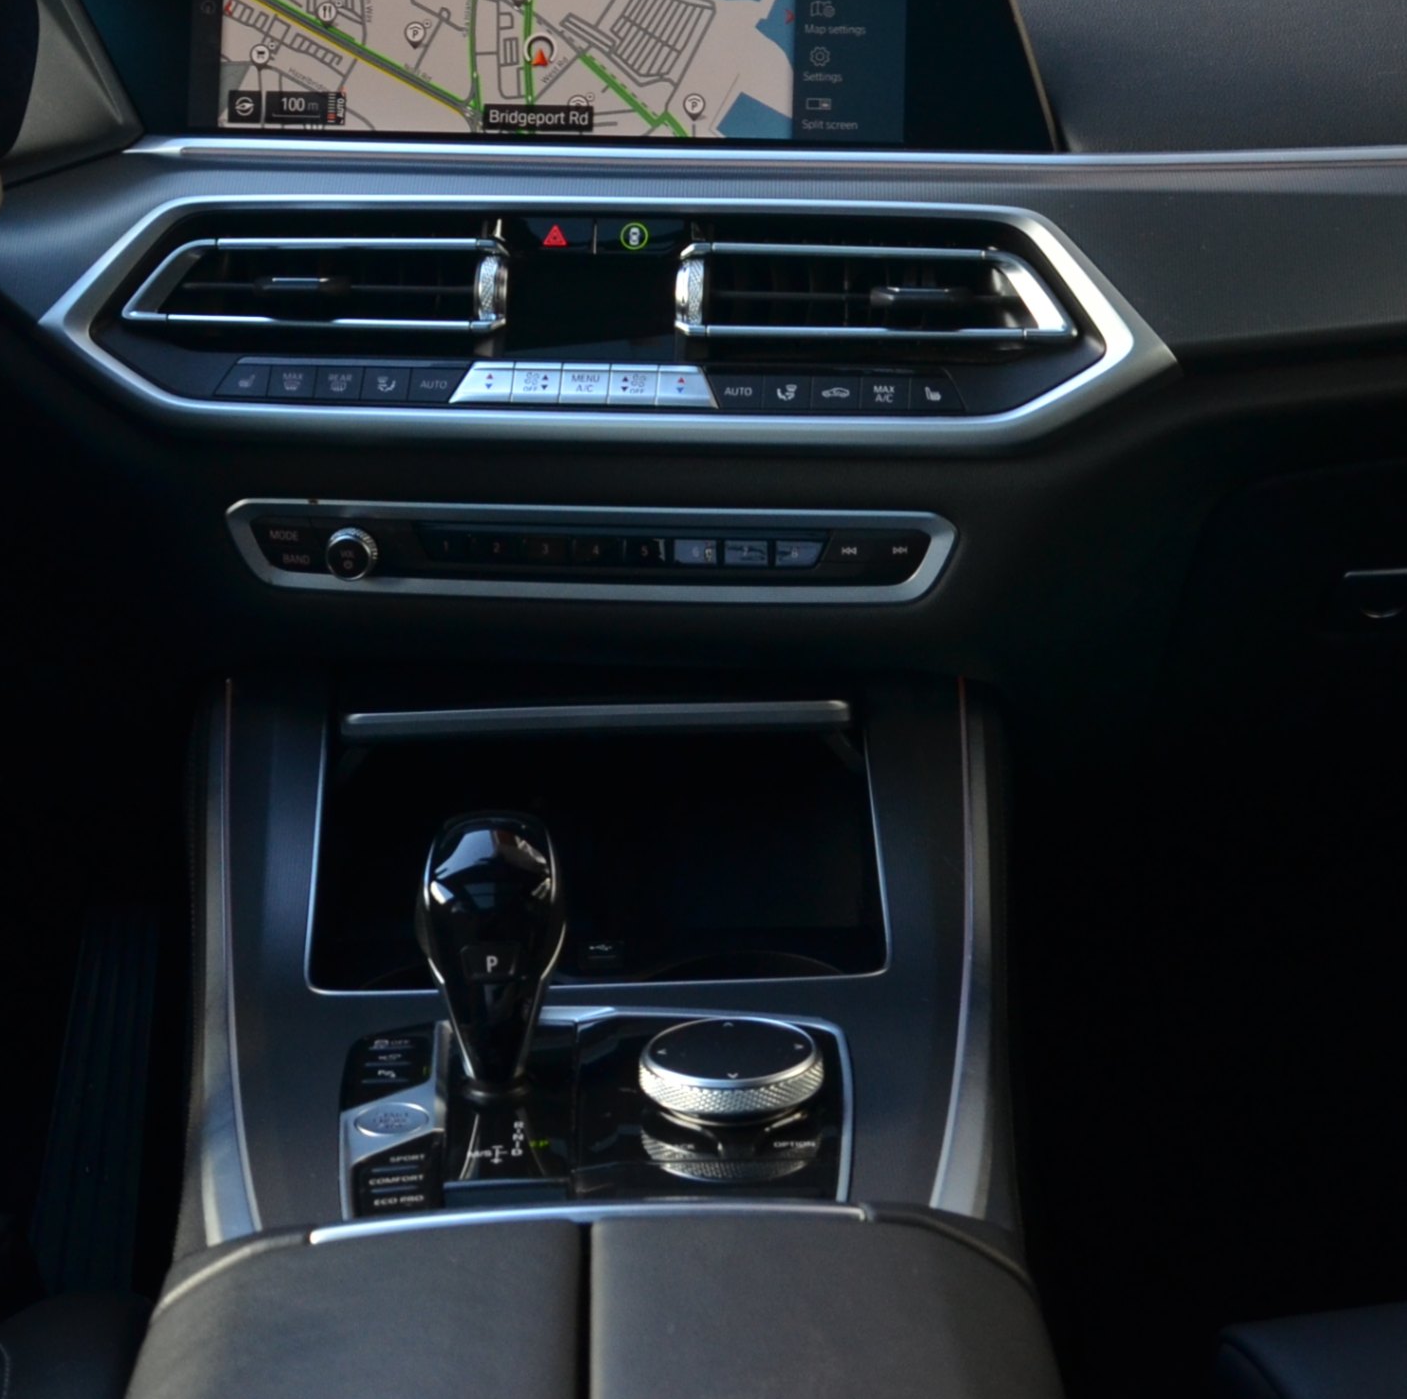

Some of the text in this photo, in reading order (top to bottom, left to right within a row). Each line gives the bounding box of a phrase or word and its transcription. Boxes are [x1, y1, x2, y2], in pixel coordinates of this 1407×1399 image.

[804, 24, 866, 37] Map settings
[803, 71, 843, 84] Settings
[281, 97, 306, 112] 100
[337, 98, 345, 117] AUTO
[489, 110, 589, 128] Bridgeport Rd
[801, 119, 858, 131] Split screen
[328, 374, 352, 382] REAR
[571, 374, 600, 383] MENU
[420, 380, 448, 389] AUTO
[576, 384, 594, 392] A/C
[873, 385, 895, 394] MAX
[724, 386, 753, 396] AUTO
[875, 394, 894, 403] A/C
[269, 530, 299, 542] MODE
[282, 553, 310, 565] BAND
[486, 955, 498, 973] P
[389, 1153, 425, 1163] SPORT
[368, 1174, 424, 1186] COMFORT
[373, 1197, 397, 1206] ECO
